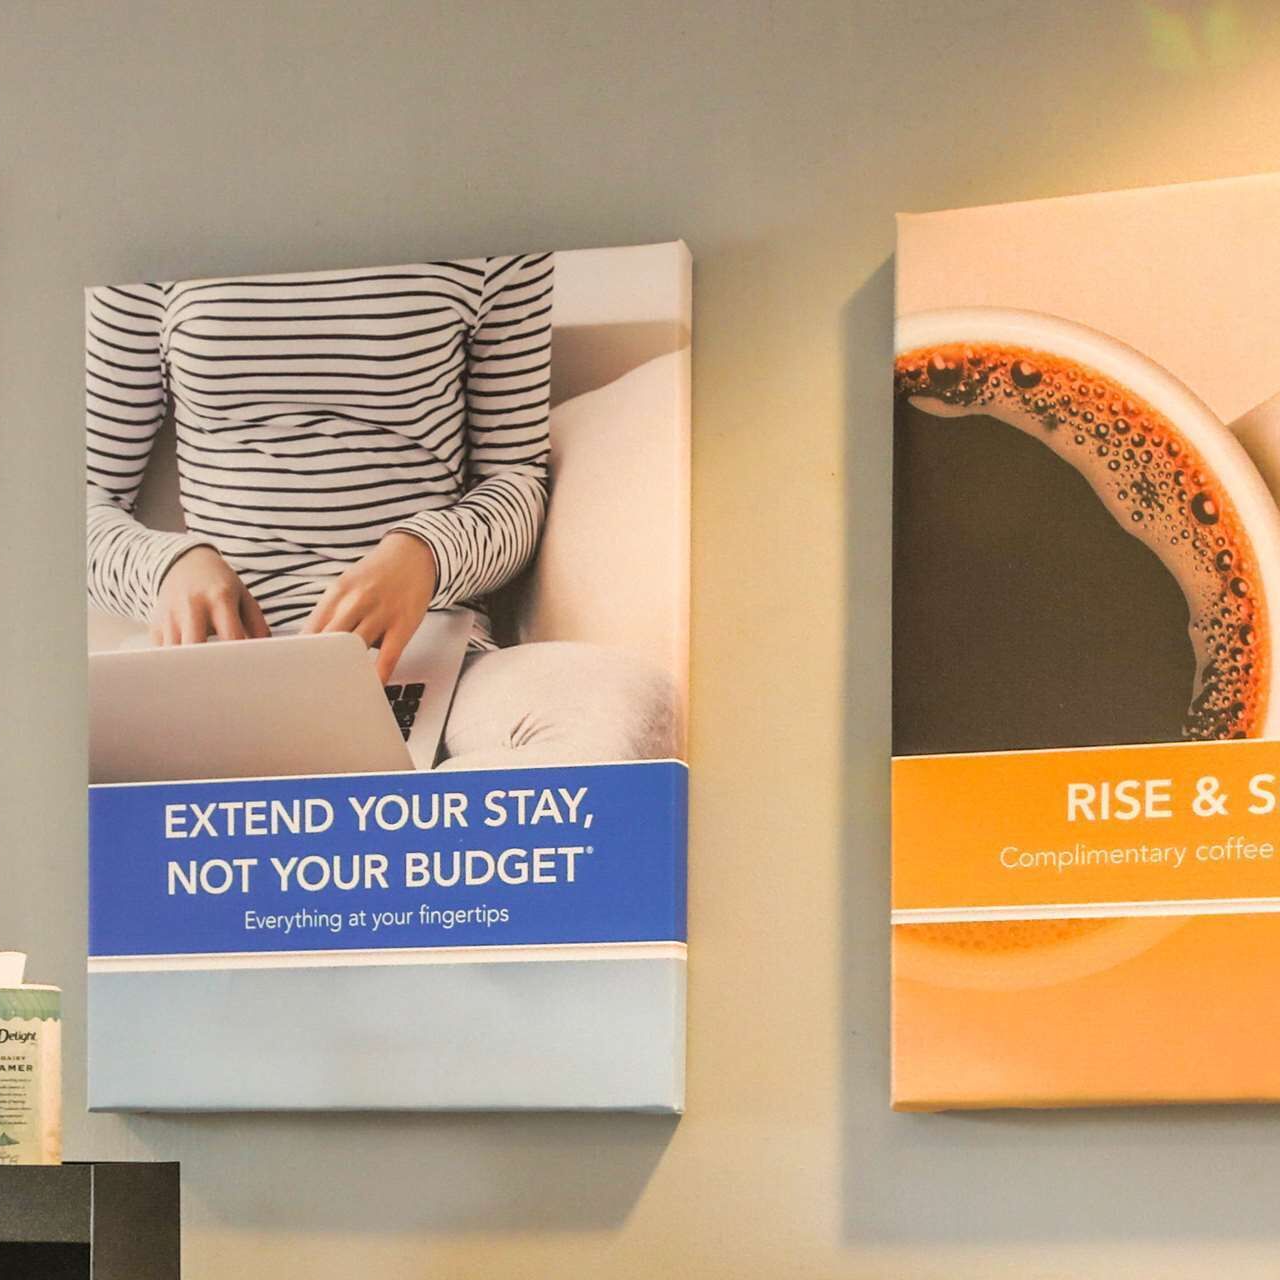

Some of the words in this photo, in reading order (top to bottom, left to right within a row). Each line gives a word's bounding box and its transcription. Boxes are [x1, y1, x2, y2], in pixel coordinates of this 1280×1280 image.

[164, 799, 334, 838] EXTEND
[348, 792, 469, 831] YOUR
[483, 787, 594, 829] STAY,
[1066, 778, 1173, 822] RISE
[1192, 776, 1229, 817] &
[167, 858, 258, 895] NOT
[270, 854, 389, 891] YOUR
[999, 843, 1186, 872] Complimentary
[1195, 836, 1274, 863] coffee
[244, 909, 342, 935] Everything
[348, 911, 367, 926] at
[371, 909, 414, 932] your
[419, 904, 509, 929] fingertips
